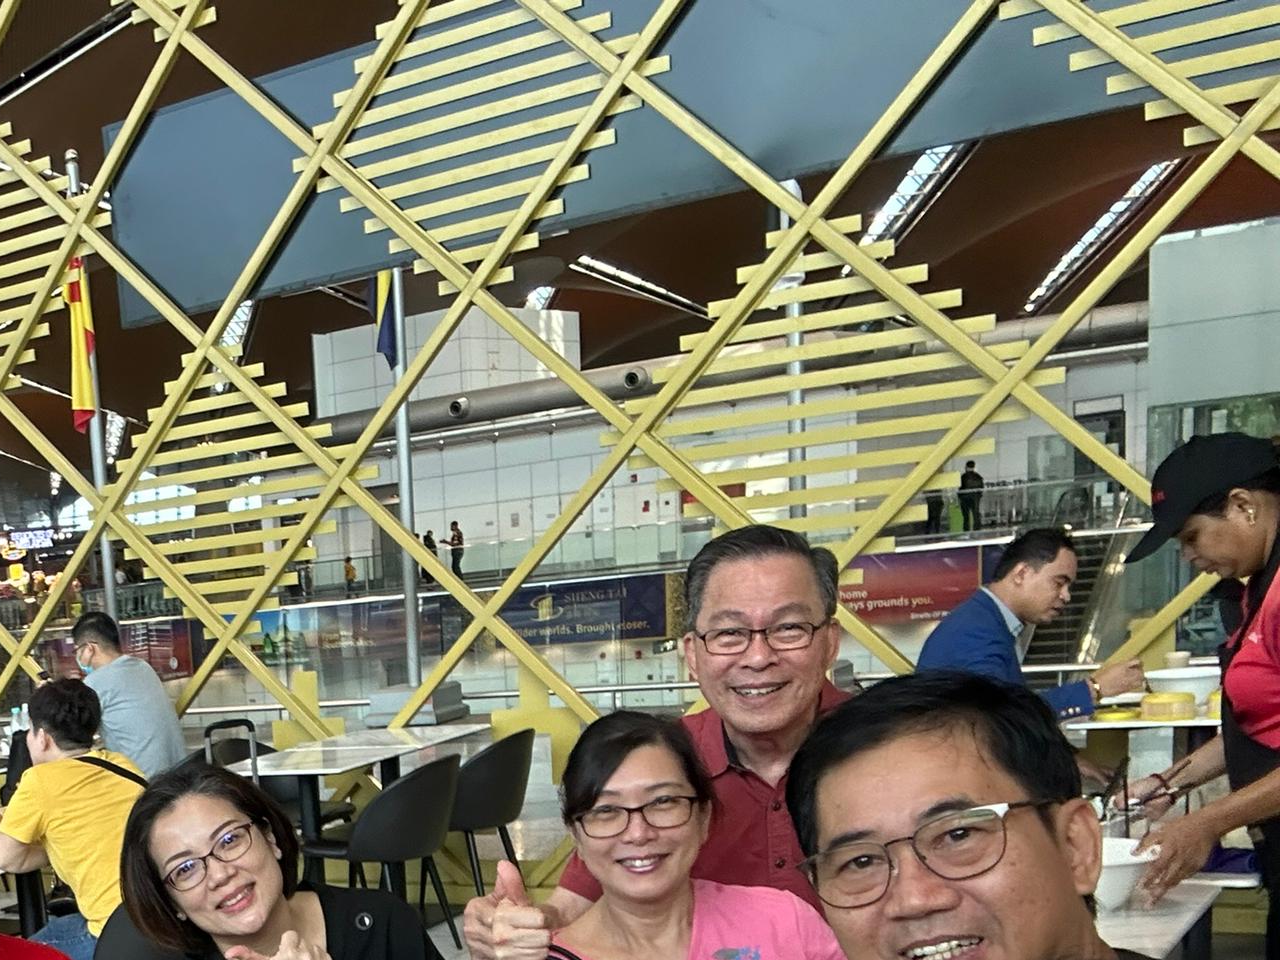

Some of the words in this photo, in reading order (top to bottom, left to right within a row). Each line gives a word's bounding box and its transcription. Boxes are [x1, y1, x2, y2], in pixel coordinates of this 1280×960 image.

[866, 596, 909, 611] grounds
[539, 624, 573, 636] worlds.
[575, 621, 614, 634] Brought
